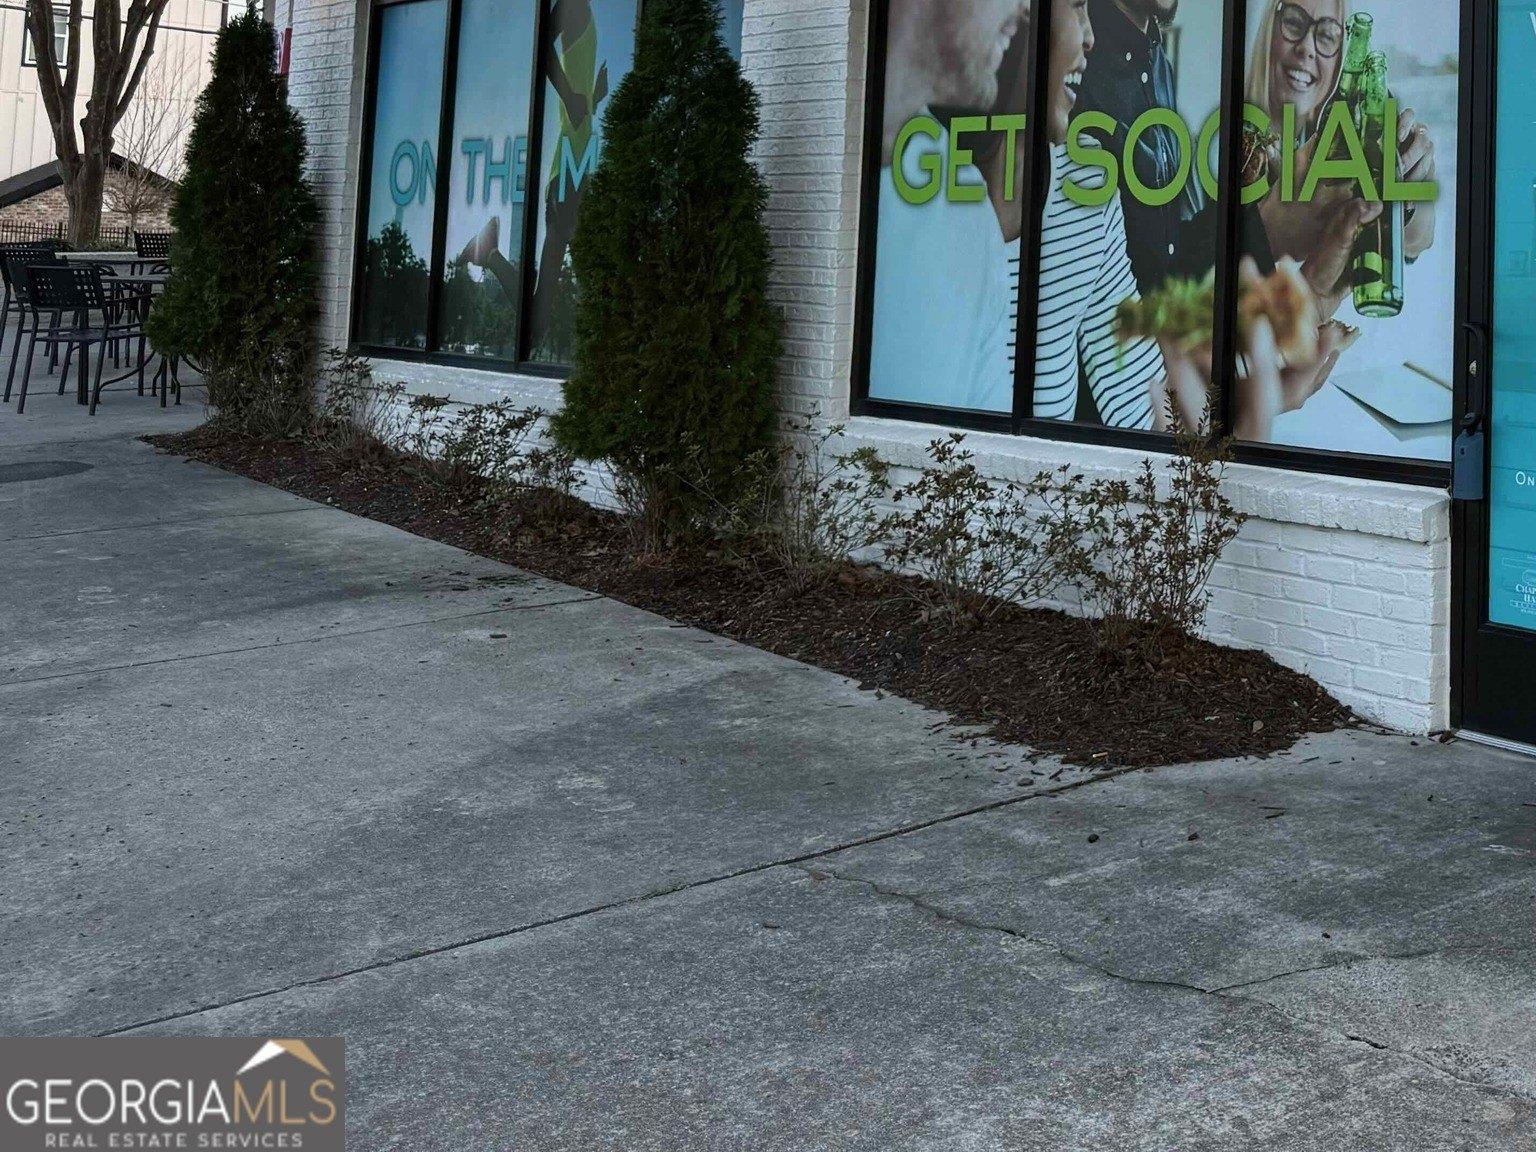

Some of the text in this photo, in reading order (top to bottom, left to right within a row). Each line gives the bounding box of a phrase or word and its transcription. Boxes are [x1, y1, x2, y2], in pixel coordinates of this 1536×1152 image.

[388, 137, 438, 207] ON
[460, 134, 528, 206] THE
[892, 99, 1441, 207] GET SOCIAL
